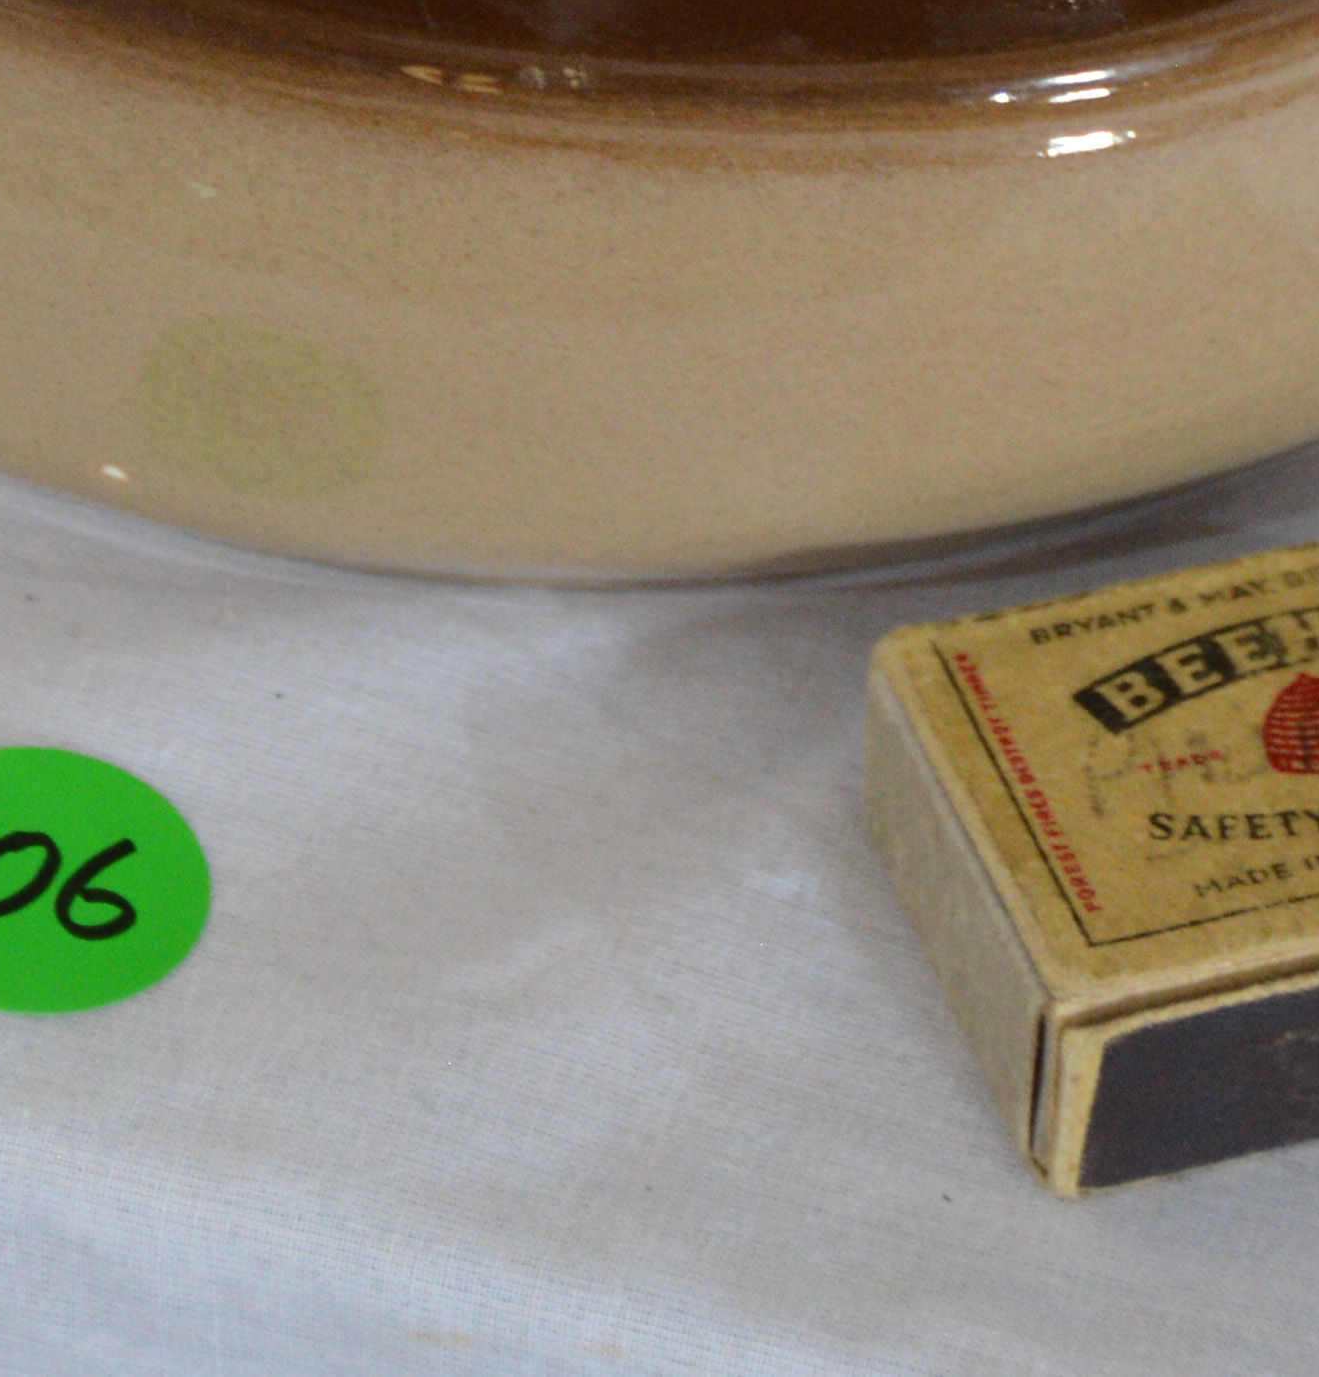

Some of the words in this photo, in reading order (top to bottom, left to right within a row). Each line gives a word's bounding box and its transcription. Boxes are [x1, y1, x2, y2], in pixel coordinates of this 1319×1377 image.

[1029, 601, 1156, 646] BRYANT
[953, 652, 997, 712] TIMBER
[987, 717, 1037, 785] DESTROY
[1023, 788, 1064, 839] FIRES
[1051, 843, 1104, 913] FOREST
[1193, 861, 1293, 898] MADE
